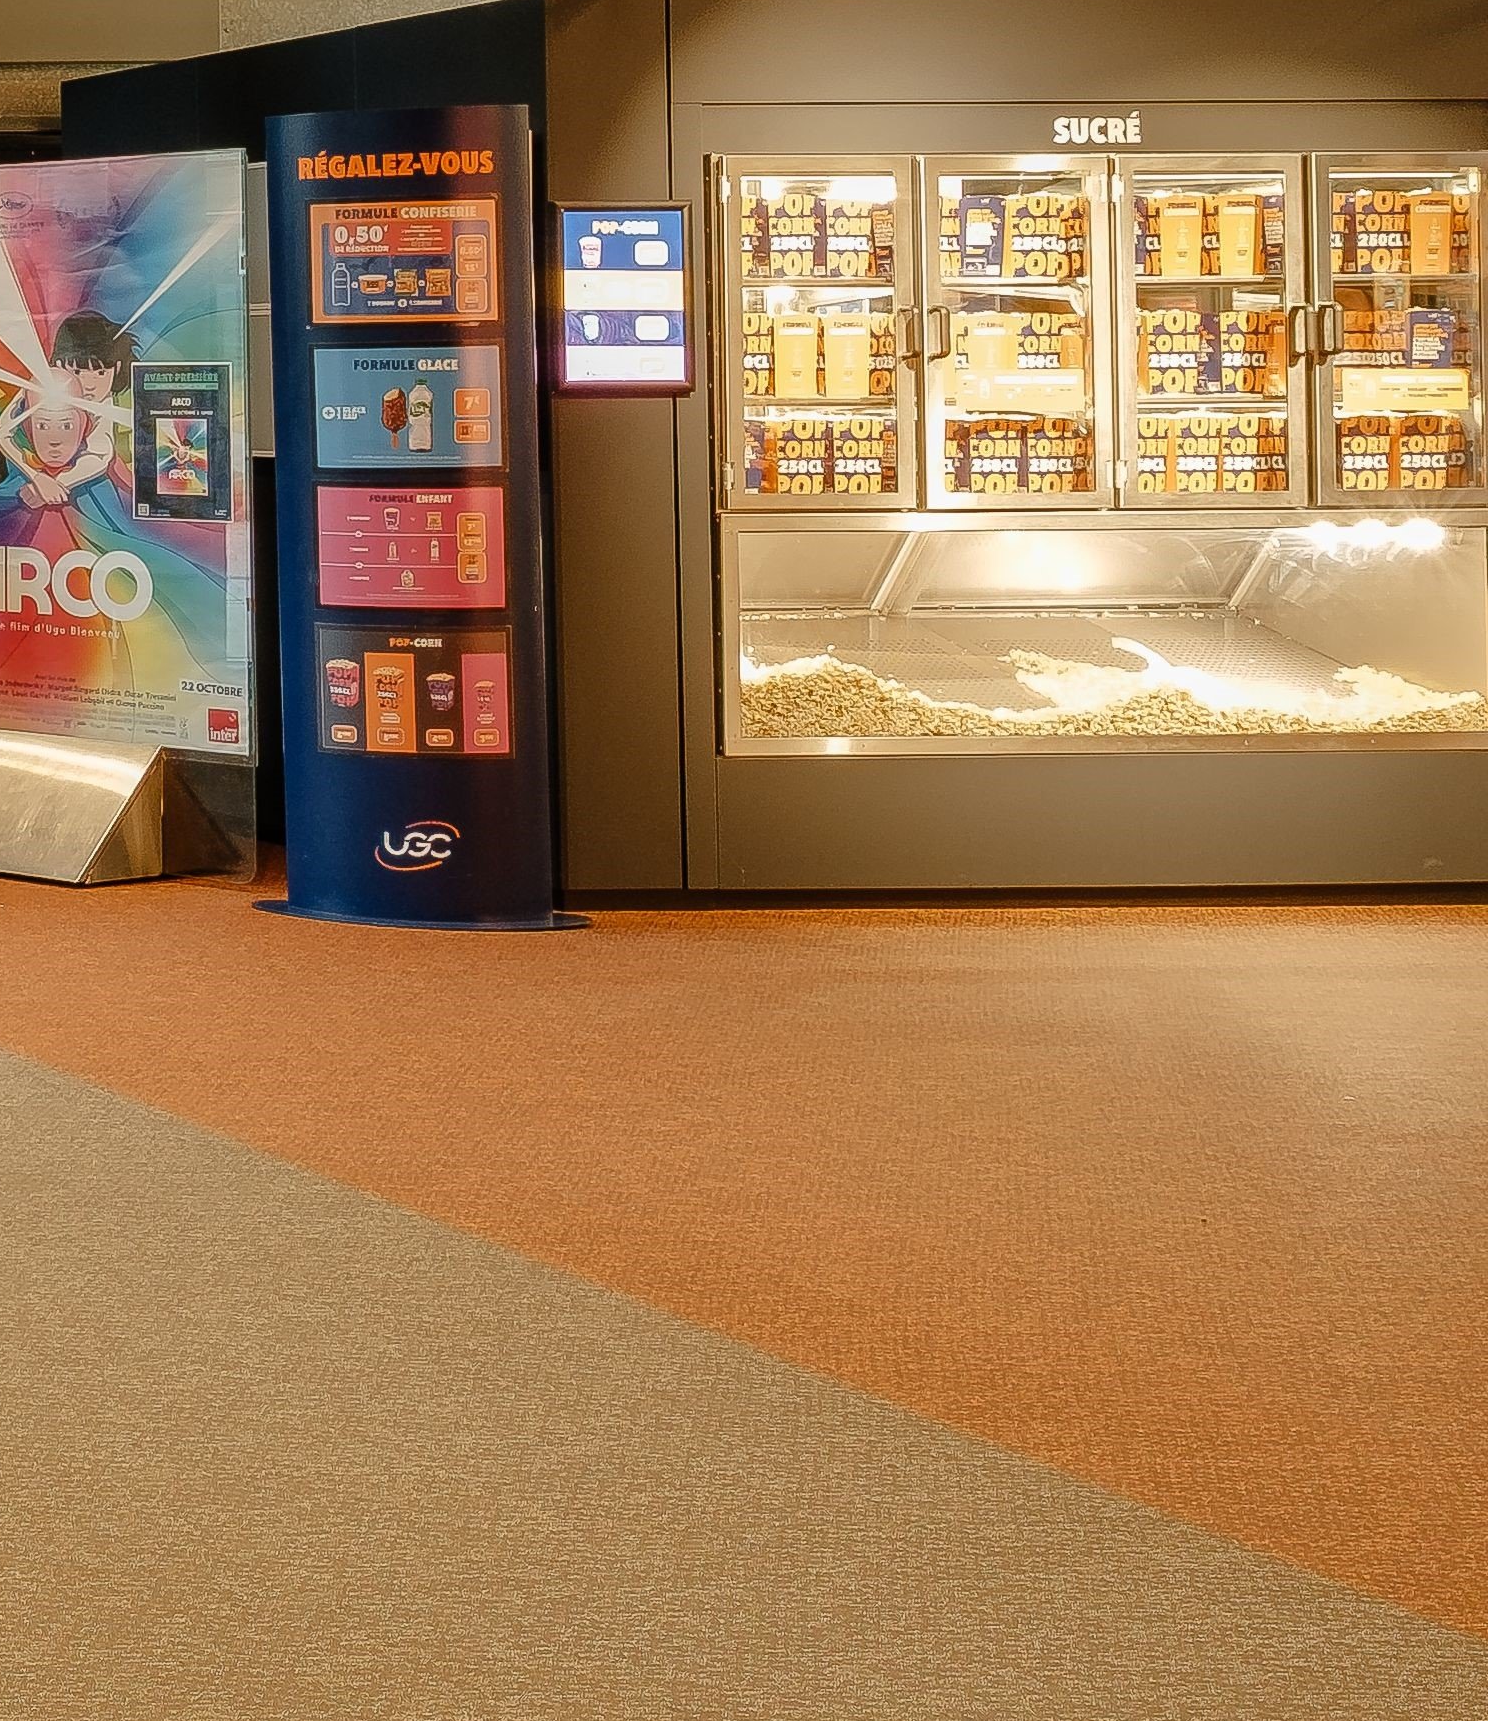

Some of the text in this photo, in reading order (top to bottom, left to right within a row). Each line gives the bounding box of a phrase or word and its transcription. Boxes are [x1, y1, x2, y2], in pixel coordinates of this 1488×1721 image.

[1052, 110, 1142, 145] SUCRÉ
[298, 150, 494, 180] RÉGALEZ-VOUS
[335, 205, 477, 220] FORMULE CONFISERIE
[353, 358, 459, 371] FORMULE GLACE
[416, 494, 453, 504] ENFANT
[10, 620, 30, 632] film
[34, 622, 66, 636] d'Ugo
[389, 637, 443, 648] POP-CORN
[181, 680, 243, 698] 22 OCTOBRE
[209, 726, 238, 742] inter
[383, 831, 452, 858] UGC
